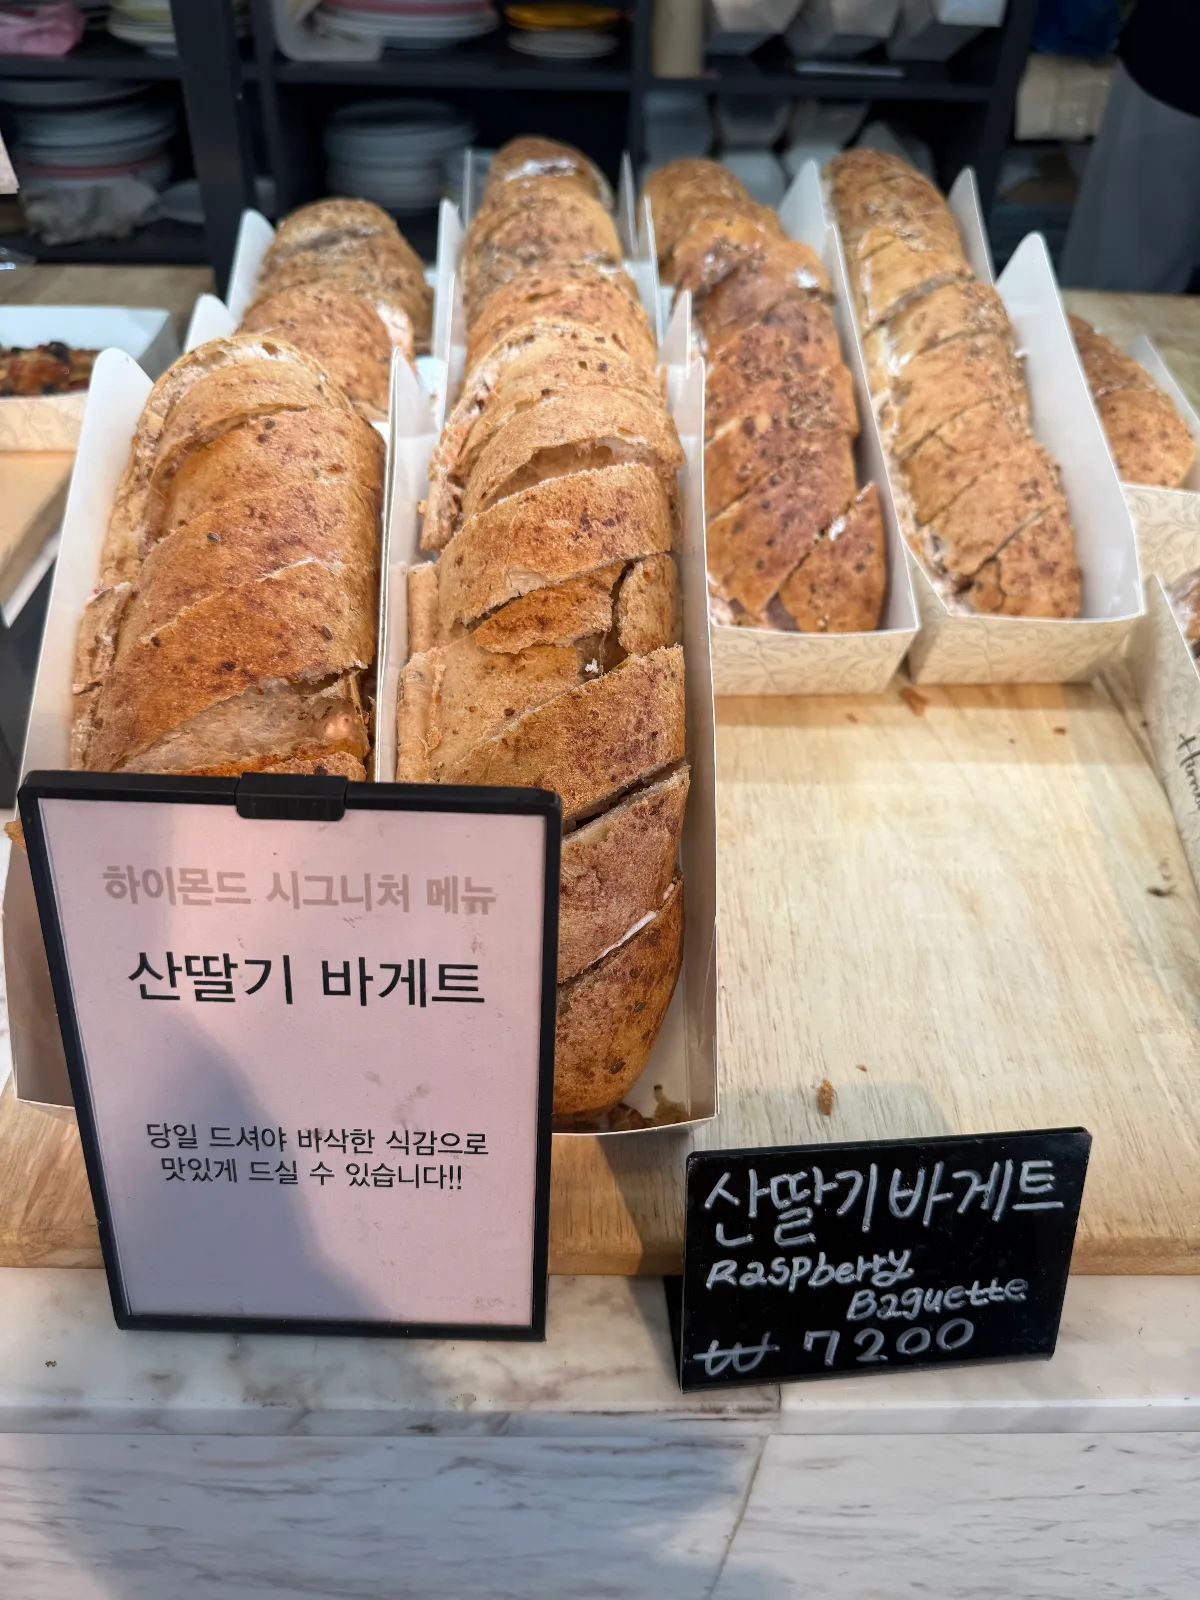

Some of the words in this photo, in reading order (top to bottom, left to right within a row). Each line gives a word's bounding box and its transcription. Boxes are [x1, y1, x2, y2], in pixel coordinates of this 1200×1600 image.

[103, 864, 252, 906] 하이몬드
[266, 870, 411, 912] 시그니처
[426, 875, 497, 915] 메뉴
[128, 951, 294, 1005] 산딸기
[321, 956, 486, 1008] 바게트
[146, 1122, 198, 1149] 당일
[209, 1125, 287, 1152] 드셔야
[297, 1128, 375, 1155] 바삭한
[385, 1129, 489, 1156] 식감으로
[161, 1156, 238, 1183] 맛있게
[248, 1160, 298, 1185] 드실
[309, 1162, 335, 1186] 수
[345, 1161, 463, 1190] 있습니다!!
[706, 1248, 914, 1292] Raspberry
[846, 1277, 1028, 1321] Baguette
[803, 1317, 974, 1366] 7200
